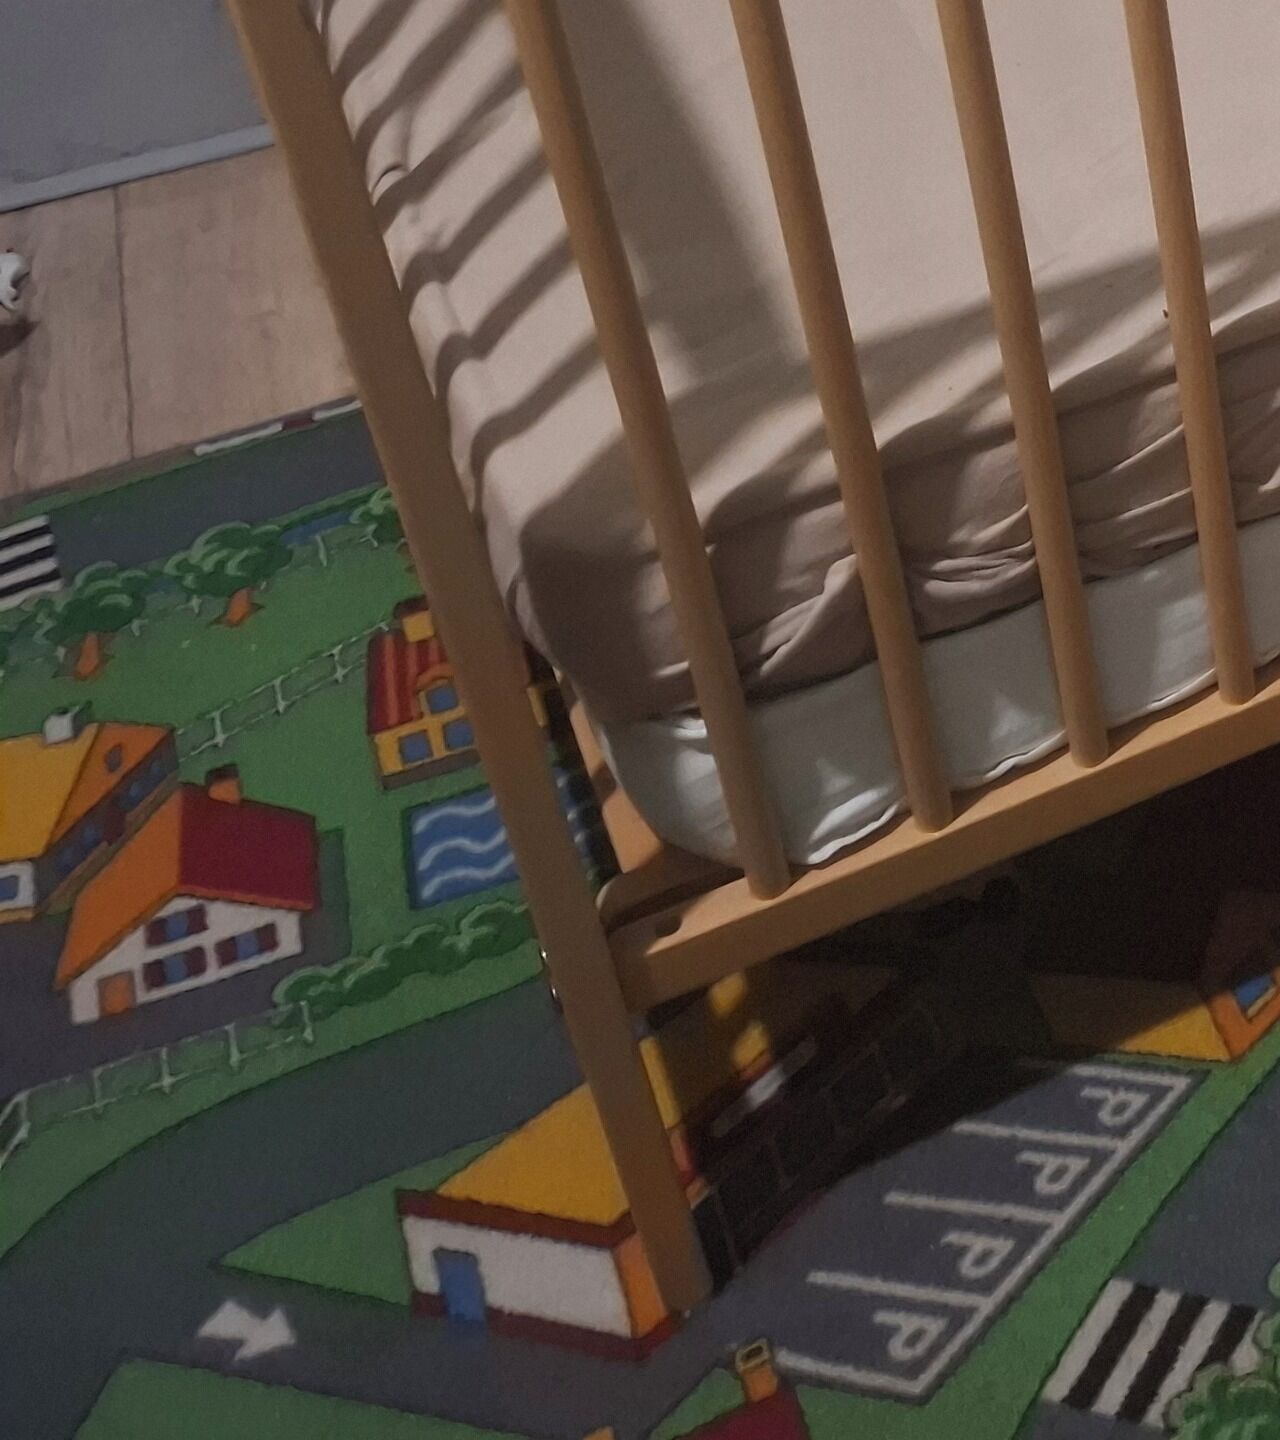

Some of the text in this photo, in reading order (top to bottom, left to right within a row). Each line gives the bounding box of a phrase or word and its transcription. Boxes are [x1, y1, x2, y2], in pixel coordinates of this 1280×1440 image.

[1080, 1086, 1150, 1127] P
[1016, 1150, 1091, 1195] P
[940, 1231, 1017, 1279] P
[872, 1310, 950, 1360] P
